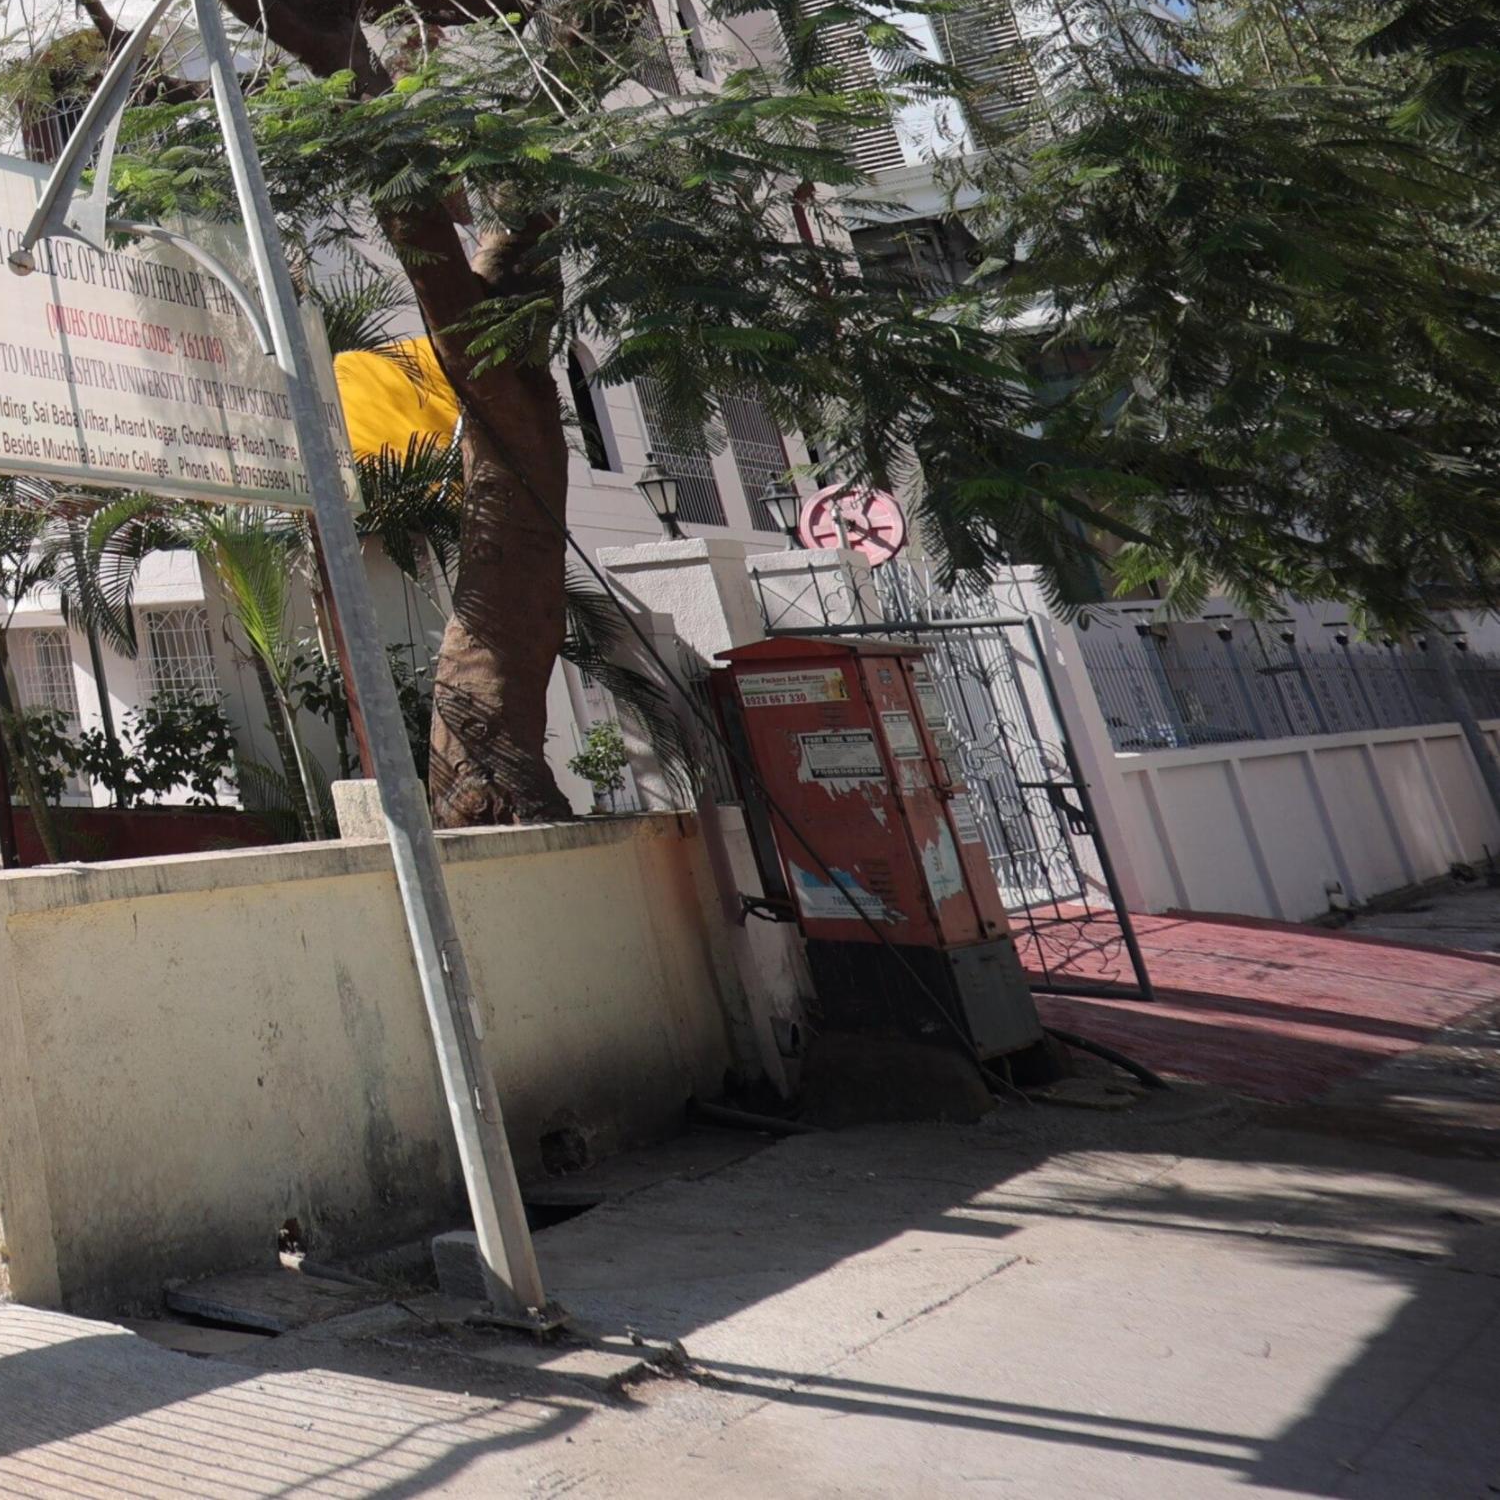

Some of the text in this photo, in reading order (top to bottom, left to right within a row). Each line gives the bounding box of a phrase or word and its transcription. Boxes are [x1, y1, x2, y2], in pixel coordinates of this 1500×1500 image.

[78, 245, 97, 285] OF
[46, 302, 88, 339] (MUHS
[89, 312, 141, 348] COLLEGE
[142, 322, 173, 354] CODE
[0, 342, 19, 374] TO
[20, 346, 118, 391] MAHARASHTRA
[117, 364, 187, 402] UNIVERSITY
[188, 377, 203, 405] OF
[203, 379, 247, 412] HEALTH
[33, 401, 49, 423] Sai
[51, 404, 79, 428] Baba
[80, 409, 113, 437] Vihar,
[114, 414, 147, 438] Anand
[148, 420, 180, 447] Nagar,
[181, 425, 240, 451] Ghodbunder
[241, 434, 269, 461] Road,
[268, 438, 298, 461] Thane
[2, 432, 41, 457] Beside
[42, 437, 96, 465] Muchhala
[99, 445, 130, 469] Junior
[132, 450, 173, 479] College.
[178, 456, 210, 481] Phone
[210, 462, 229, 483] No.
